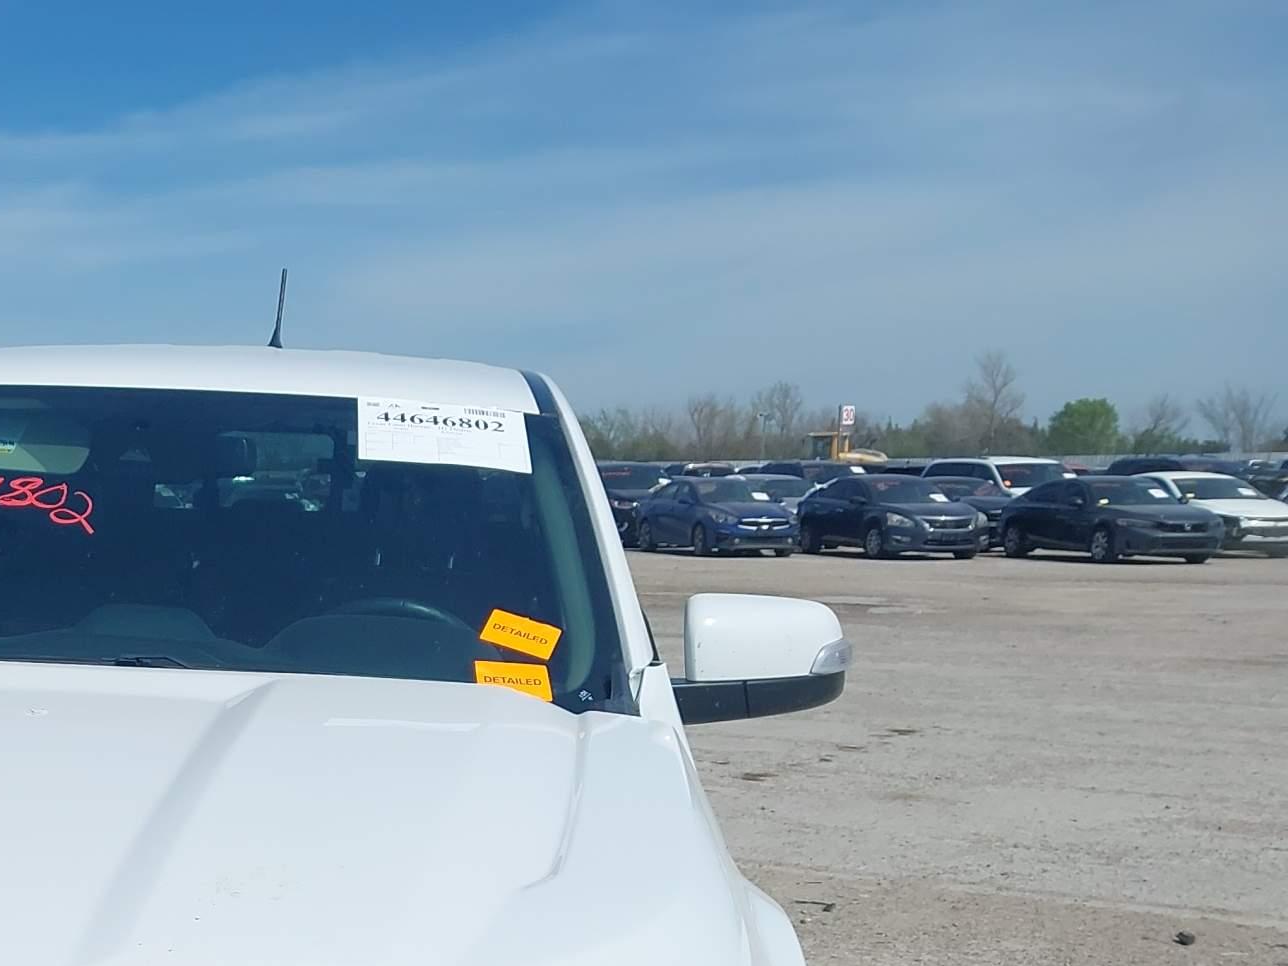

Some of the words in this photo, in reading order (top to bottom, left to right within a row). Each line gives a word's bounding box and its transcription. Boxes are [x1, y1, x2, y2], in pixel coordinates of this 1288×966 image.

[376, 411, 505, 433] 44646802
[492, 622, 548, 645] DETAILED
[483, 675, 543, 686] DETAILED
